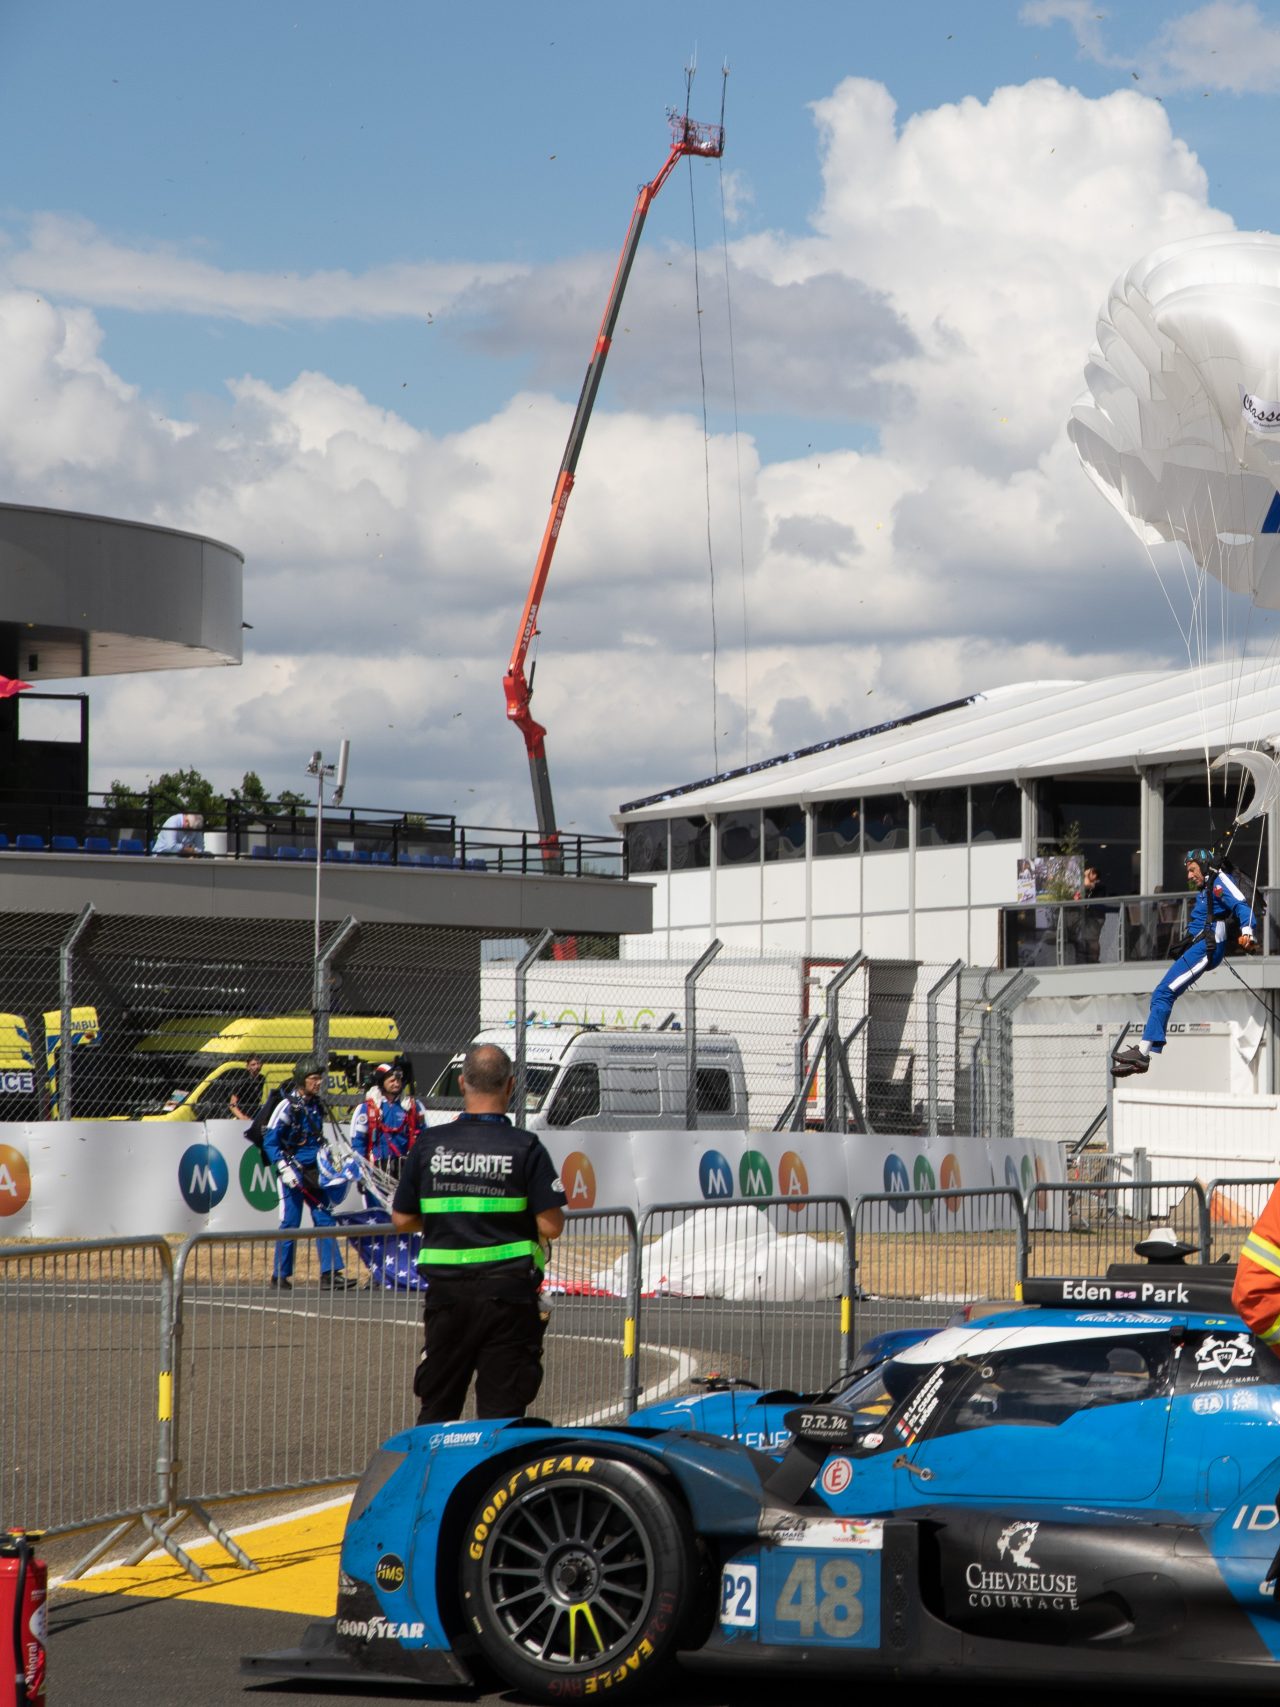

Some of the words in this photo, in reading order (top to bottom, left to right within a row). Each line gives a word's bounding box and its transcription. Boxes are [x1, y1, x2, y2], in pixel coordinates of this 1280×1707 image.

[430, 1154, 513, 1174] SECURITE
[1062, 1280, 1111, 1301] Eden
[1141, 1282, 1189, 1303] Park
[966, 1562, 1078, 1594] CHEVREUSE
[775, 1558, 864, 1639] 48
[968, 1595, 1081, 1611] COURTAGE
[336, 1616, 425, 1643] GOODYEAR
